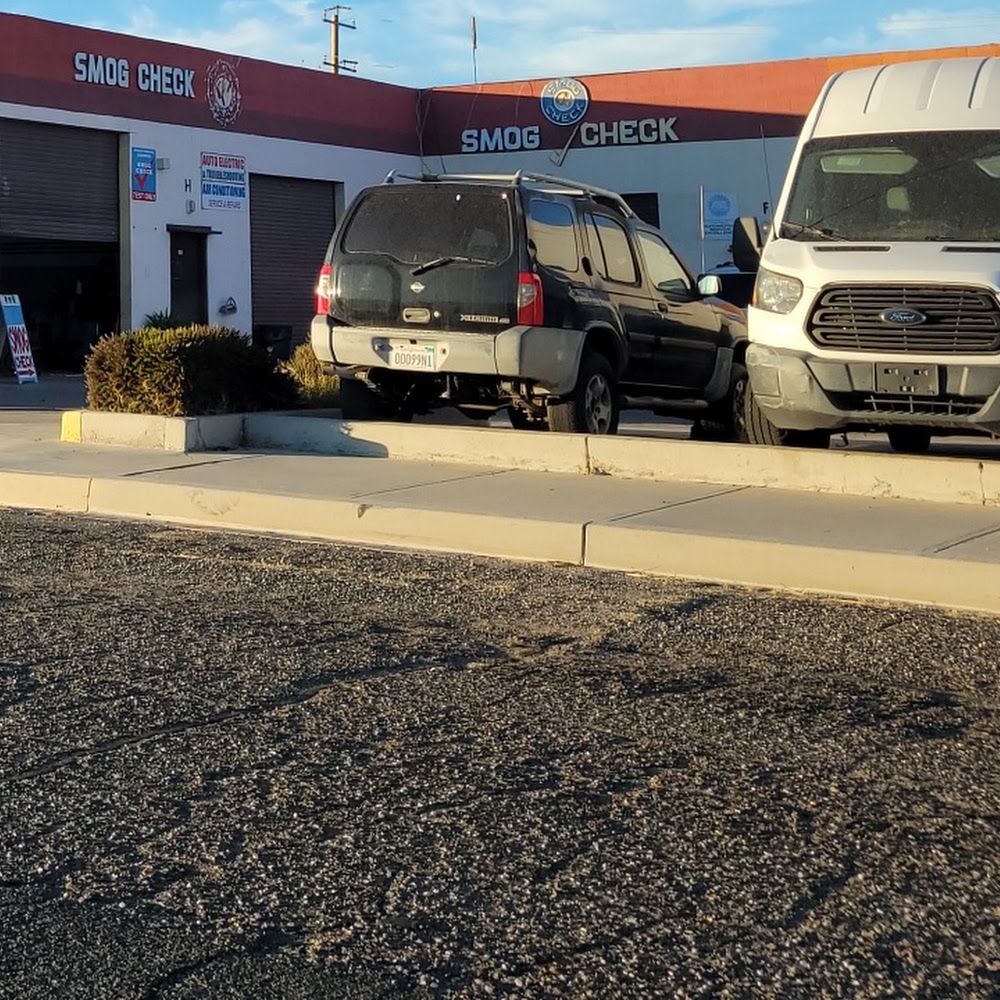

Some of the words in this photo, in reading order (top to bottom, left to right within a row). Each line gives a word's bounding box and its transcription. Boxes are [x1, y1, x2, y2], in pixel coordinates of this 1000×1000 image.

[74, 52, 129, 88] SMOG
[138, 63, 196, 98] CHECK
[547, 79, 581, 95] SMOG
[545, 103, 584, 122] CHECK
[461, 126, 540, 152] SMOG
[580, 117, 679, 146] CHECK
[184, 179, 192, 193] H
[762, 202, 769, 214] F
[15, 355, 34, 369] CHECK
